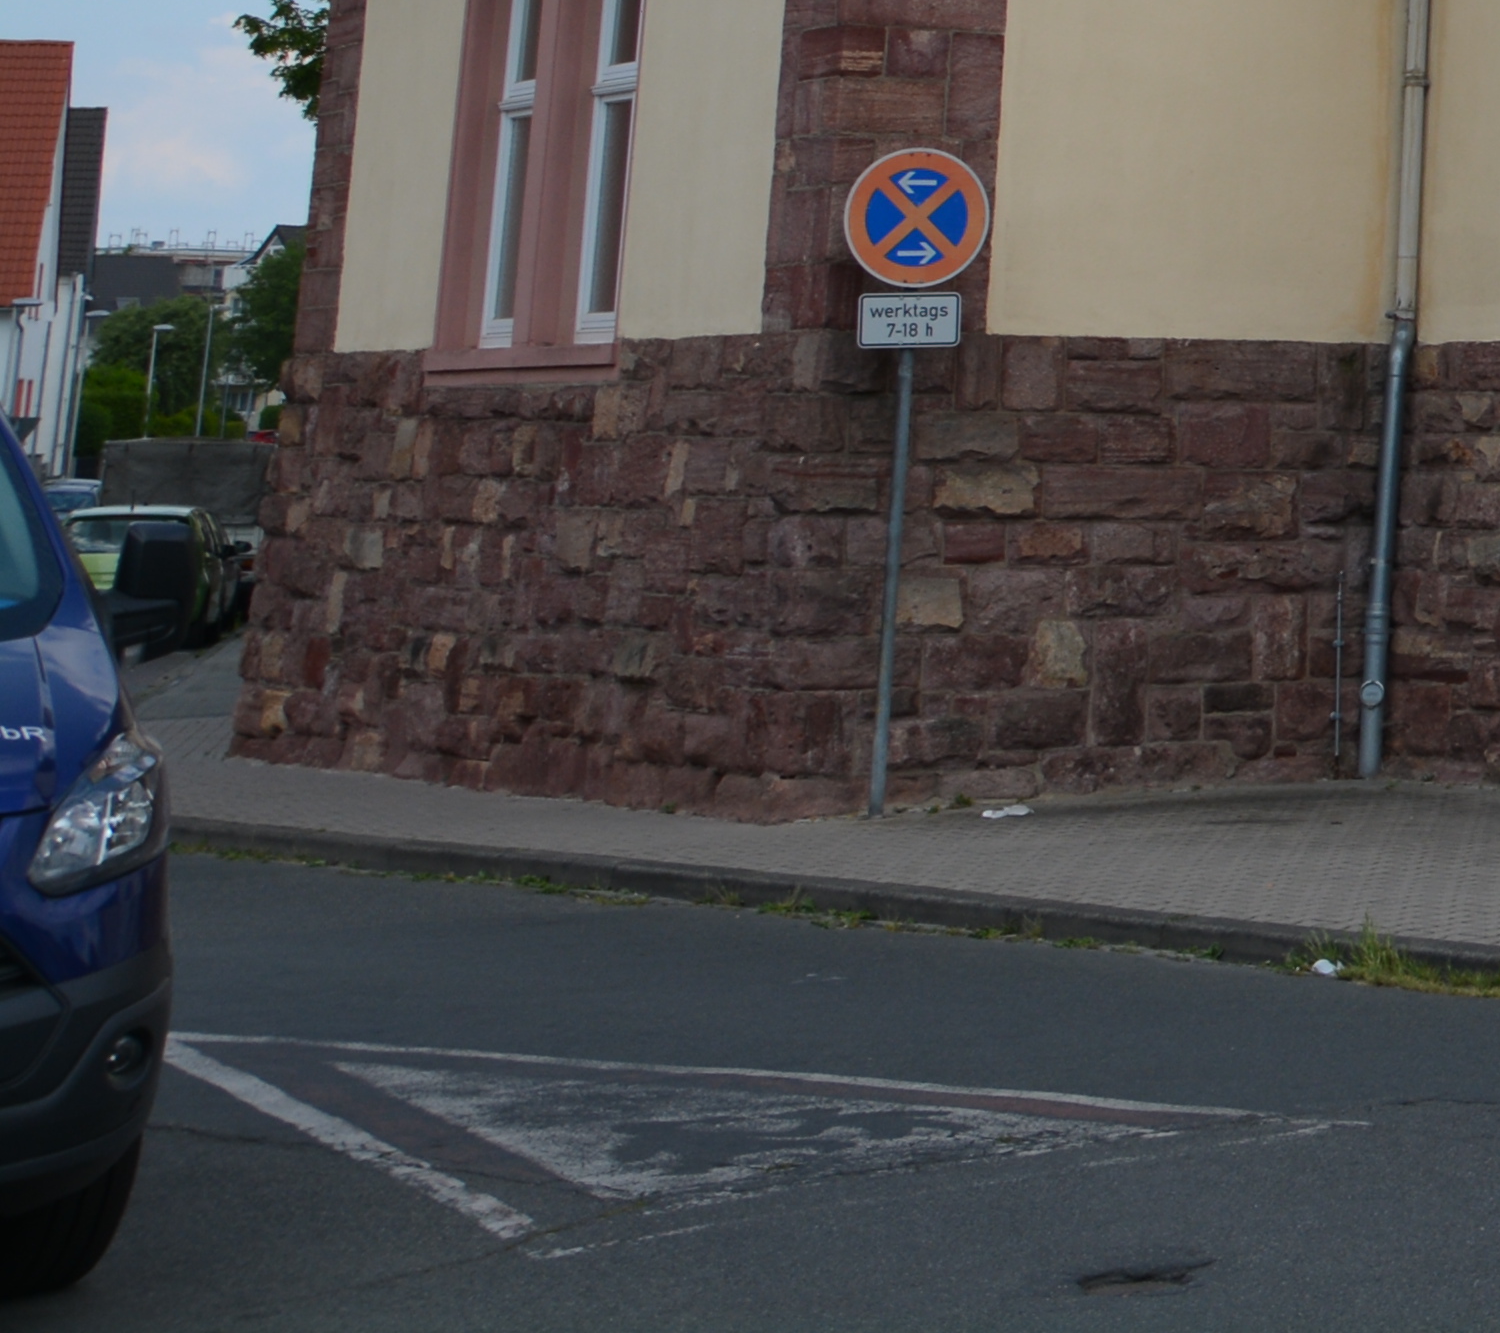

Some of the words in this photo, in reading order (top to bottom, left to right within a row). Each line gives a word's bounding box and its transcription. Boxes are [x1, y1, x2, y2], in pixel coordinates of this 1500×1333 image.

[869, 303, 949, 321] werktags
[886, 322, 919, 338] 7-18
[925, 322, 934, 337] h
